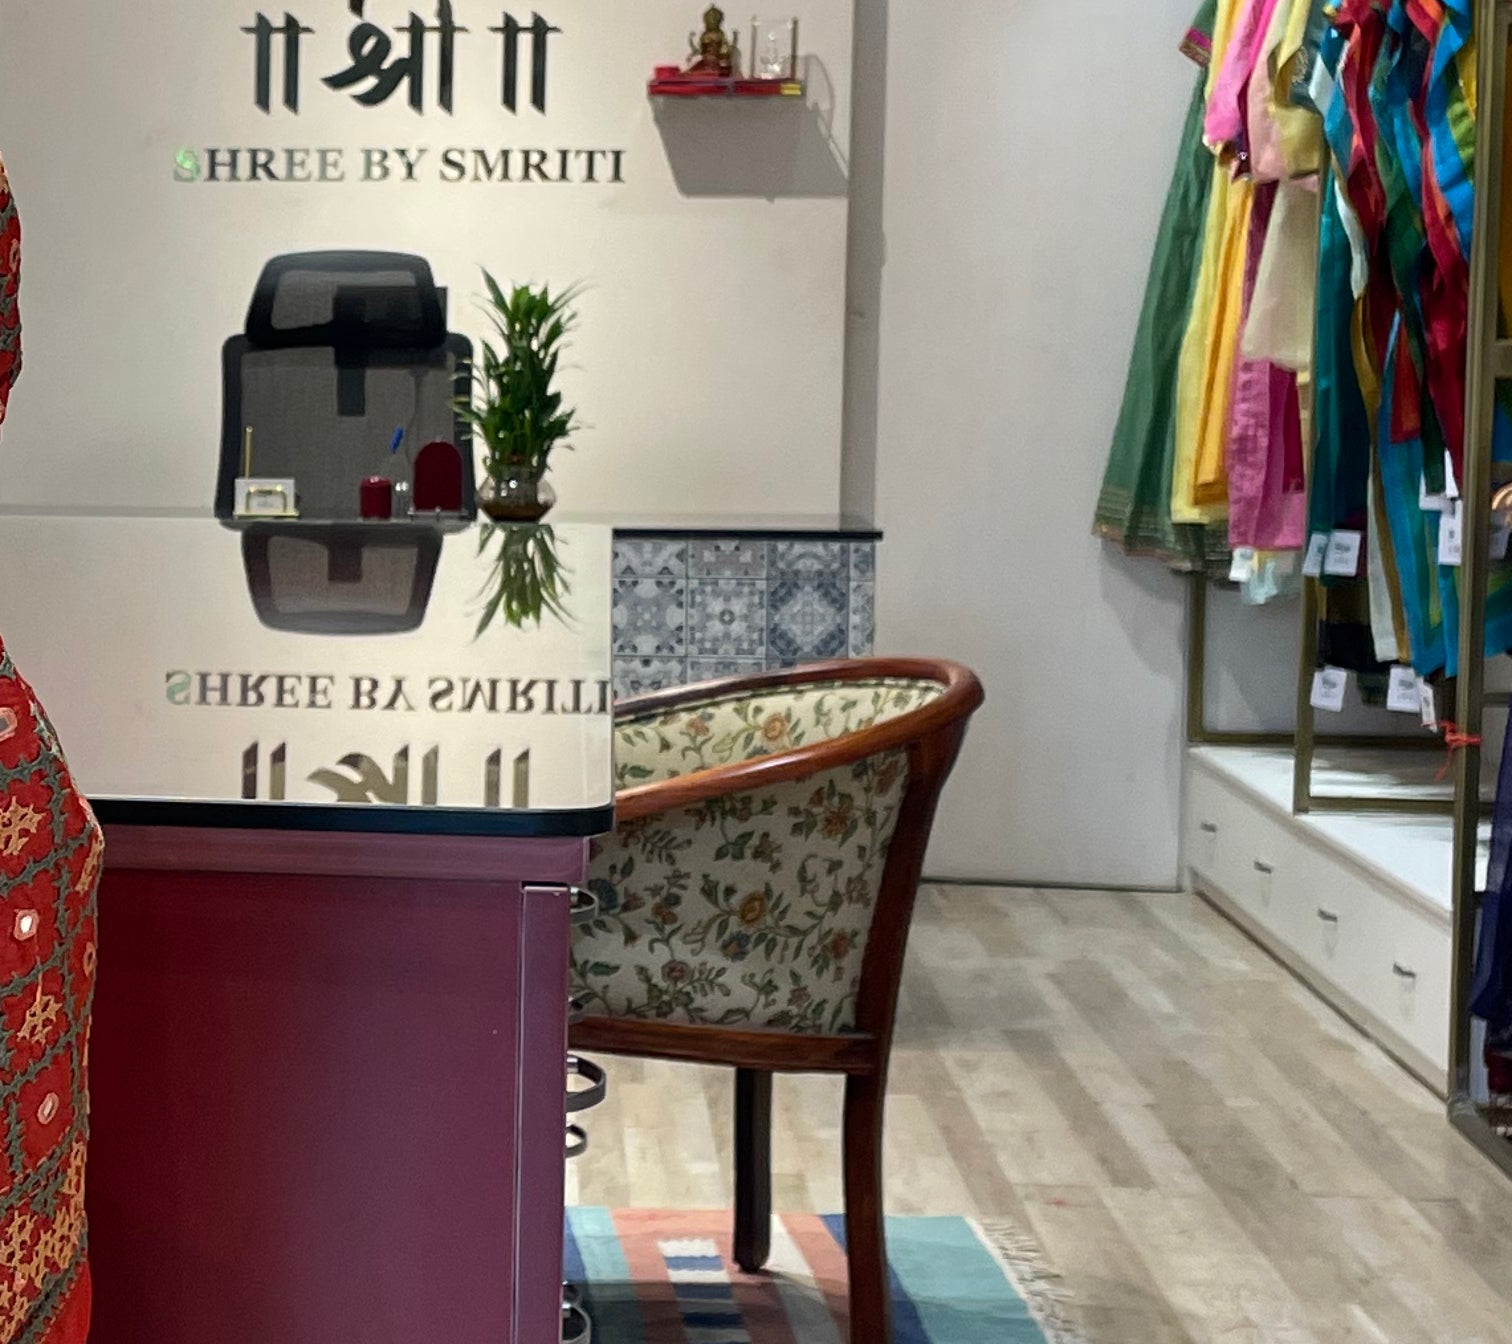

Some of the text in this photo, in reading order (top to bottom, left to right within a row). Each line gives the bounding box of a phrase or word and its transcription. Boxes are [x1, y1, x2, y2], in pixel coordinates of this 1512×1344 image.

[172, 147, 627, 184] SHREE BY SMRITI
